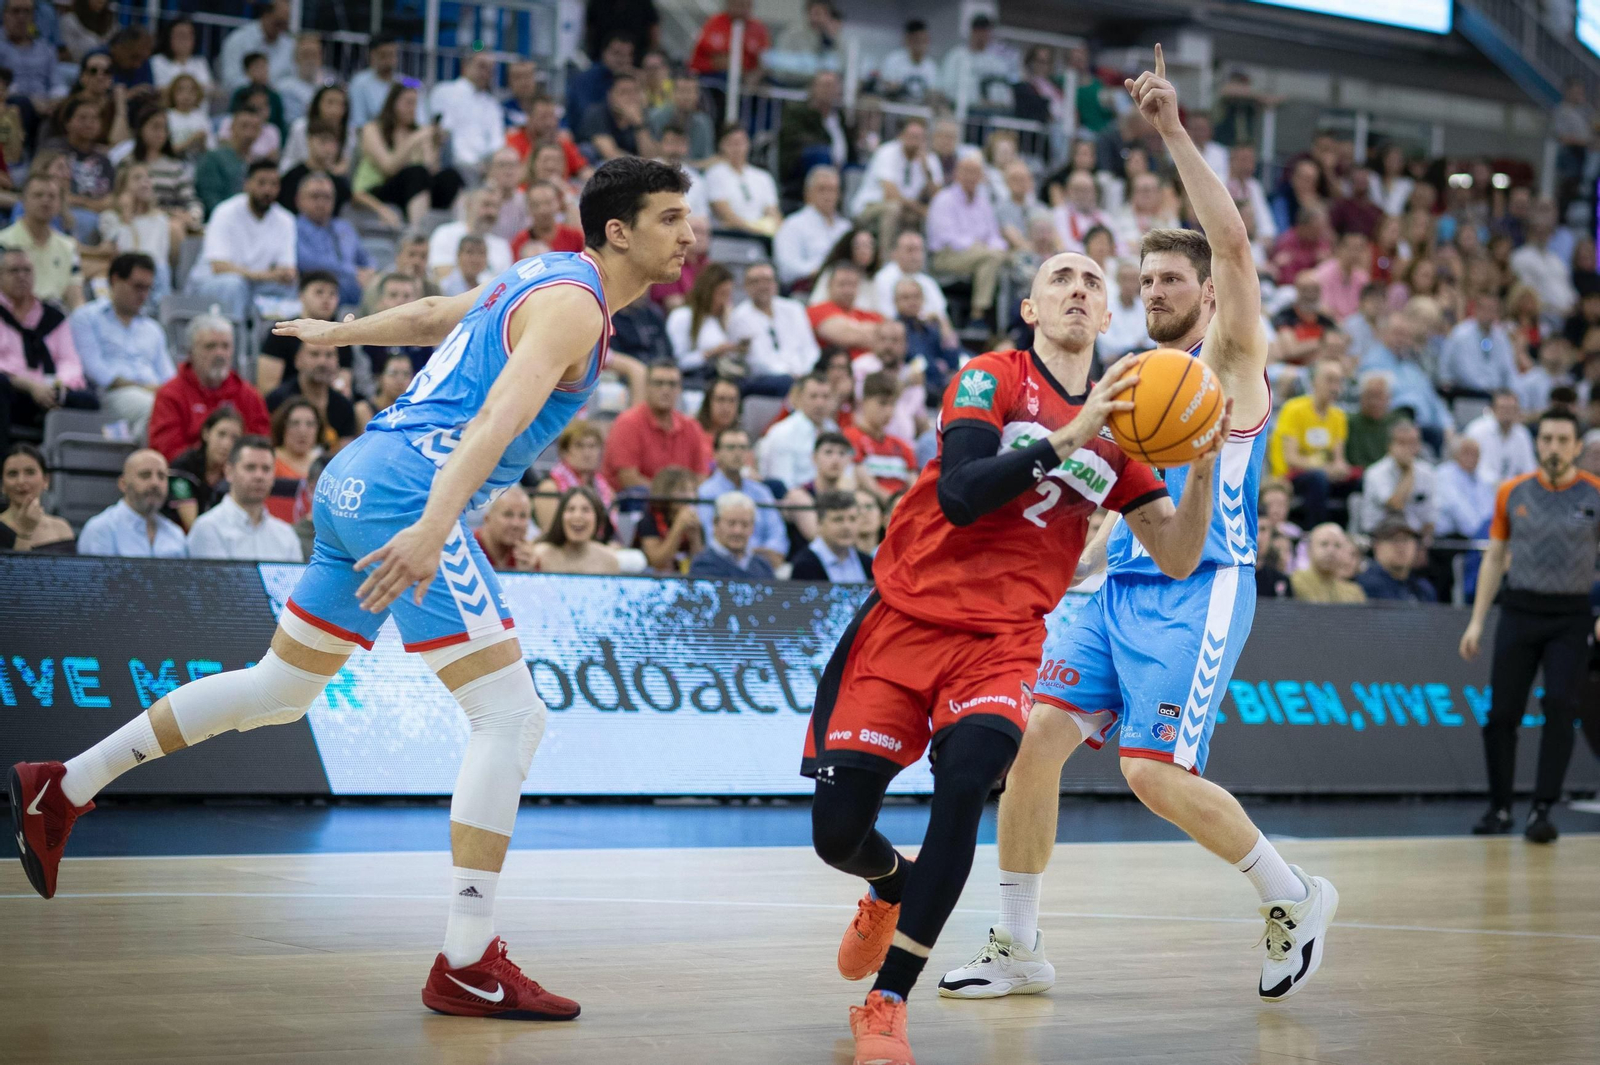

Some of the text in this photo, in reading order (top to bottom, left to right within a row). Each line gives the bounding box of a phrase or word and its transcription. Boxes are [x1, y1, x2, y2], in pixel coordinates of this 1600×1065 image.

[1010, 433, 1109, 495] CRAN
[1022, 480, 1062, 528] 2
[1038, 659, 1080, 686] Río
[1160, 707, 1176, 717] acb
[828, 730, 853, 741] vive
